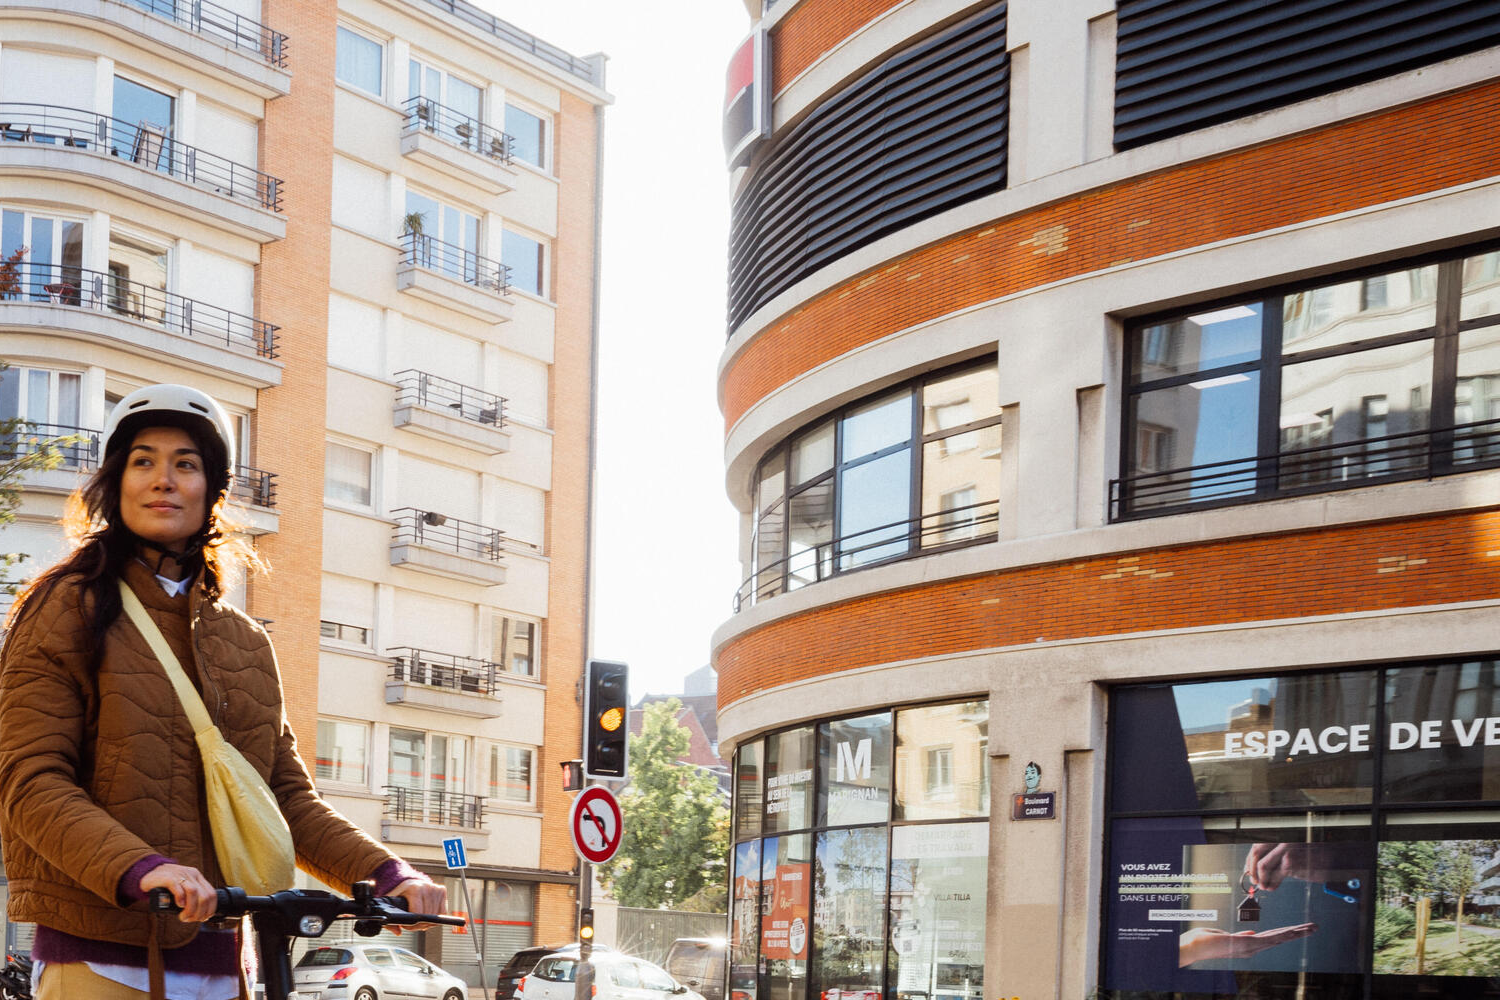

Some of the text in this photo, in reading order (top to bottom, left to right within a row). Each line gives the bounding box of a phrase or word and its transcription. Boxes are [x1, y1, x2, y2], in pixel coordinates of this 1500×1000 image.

[1224, 717, 1500, 758] ESPACE DE VE
[836, 738, 872, 782] M
[1025, 807, 1048, 815] CARNOT
